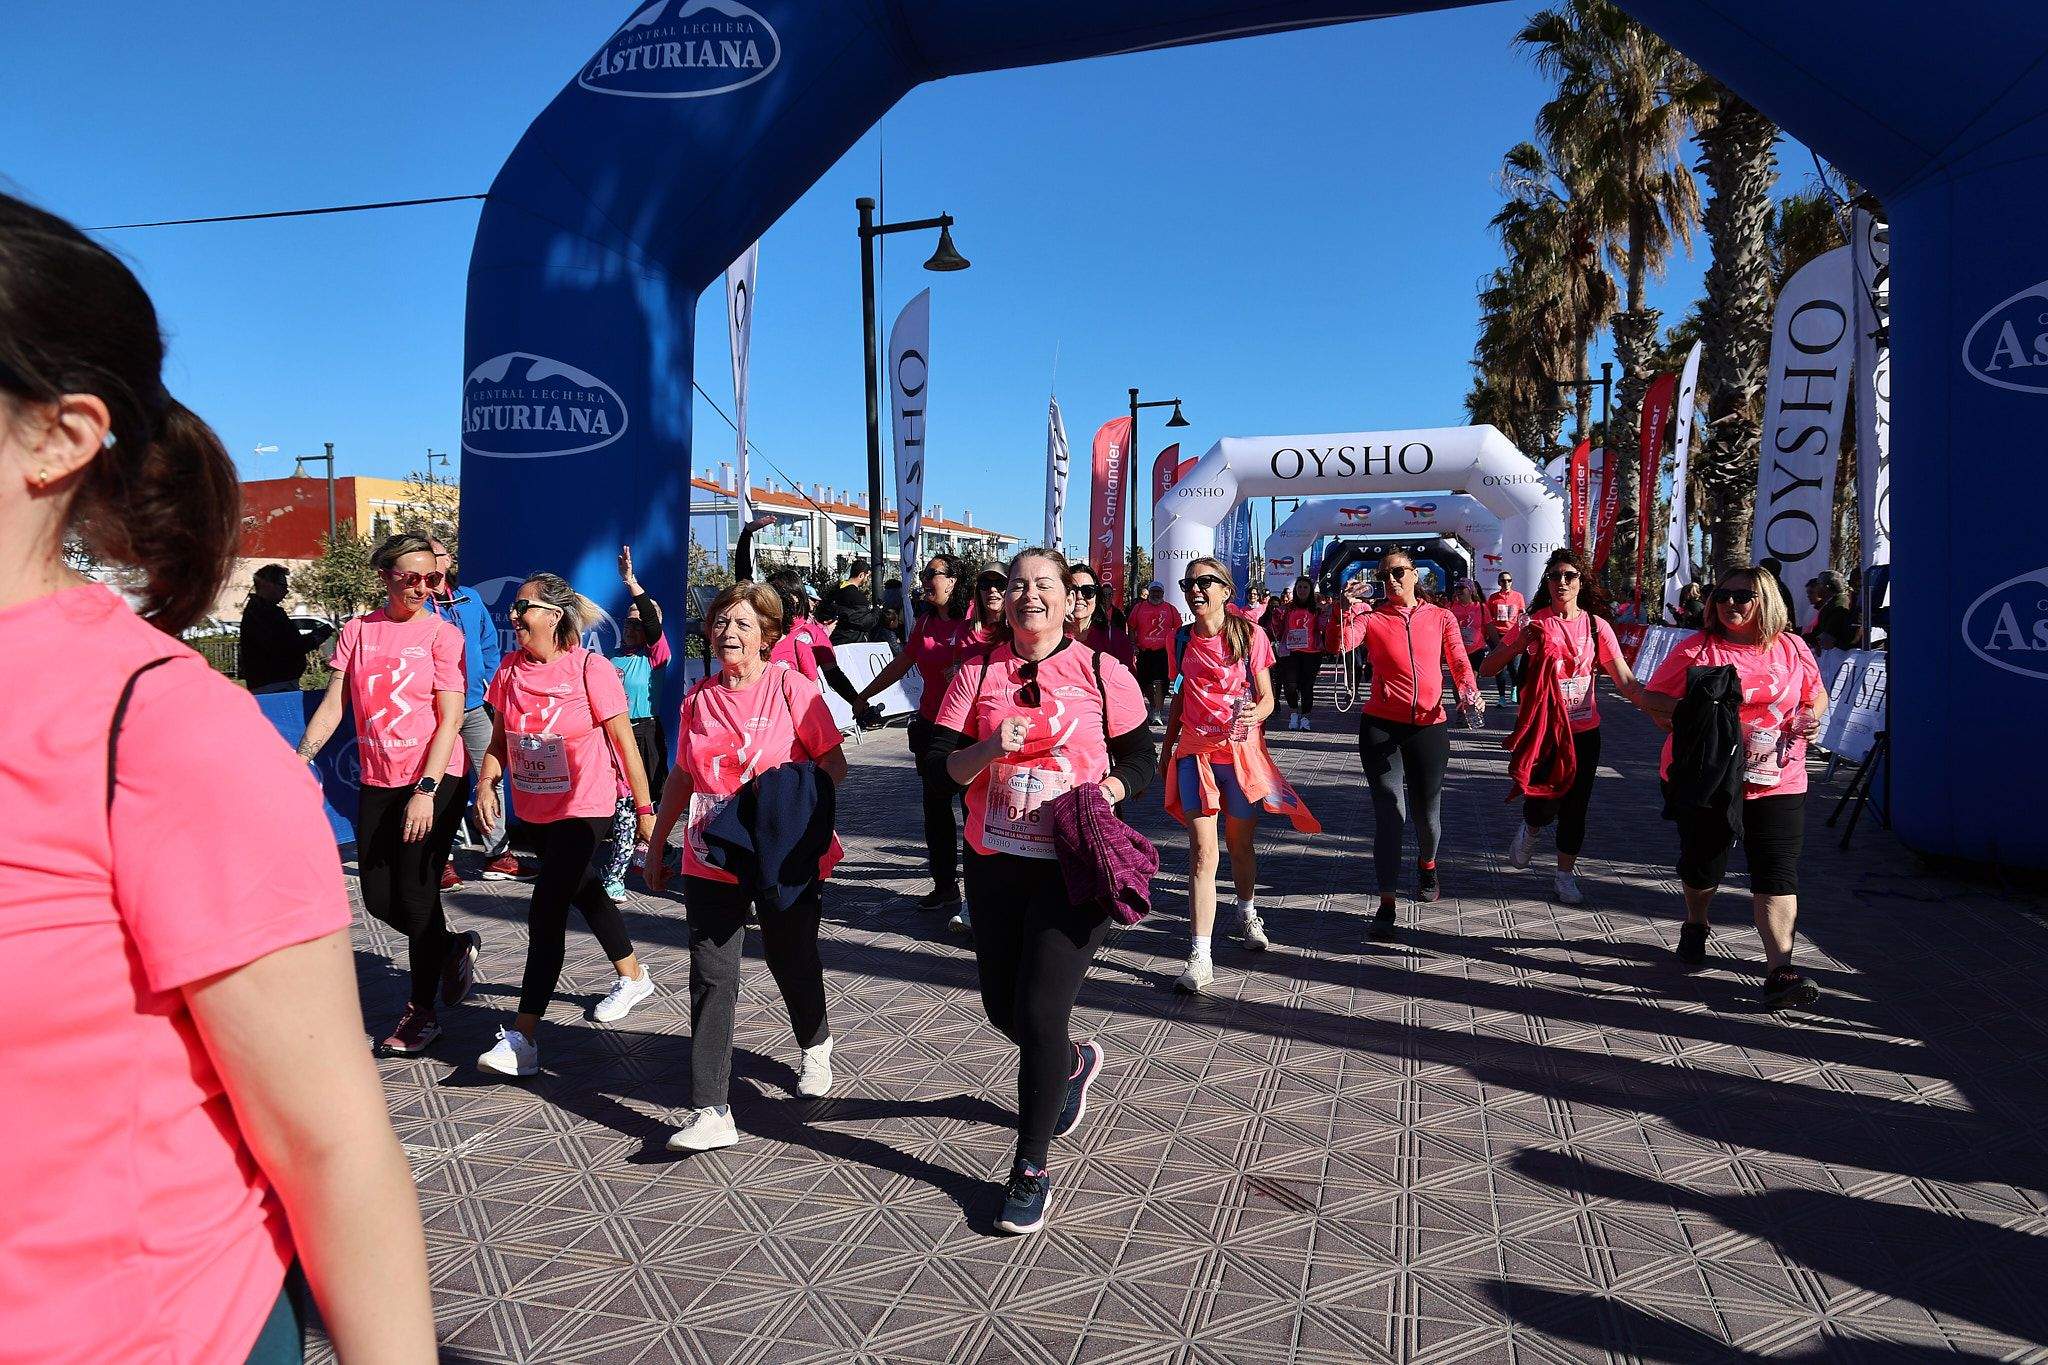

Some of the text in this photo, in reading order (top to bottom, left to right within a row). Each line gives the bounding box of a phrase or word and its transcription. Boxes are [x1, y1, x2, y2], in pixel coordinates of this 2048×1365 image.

[619, 22, 755, 47] CENTRAL LECHERA
[586, 39, 763, 82] ASTURIANA
[473, 389, 605, 403] CENTRAL LECHERA
[462, 396, 612, 435] ASTURIANA
[1764, 299, 1847, 563] OYSHO
[897, 348, 926, 574] OYSHO
[1270, 442, 1434, 480] OYSHO
[1103, 441, 1120, 526] Santander
[1178, 486, 1224, 498] OYSHO
[1482, 474, 1535, 486] OYSHO
[1158, 549, 1200, 561] OYSHO
[1511, 543, 1559, 554] OYSHO
[1830, 662, 1886, 712] OYSH
[524, 761, 546, 771] 016
[1008, 805, 1040, 823] 016
